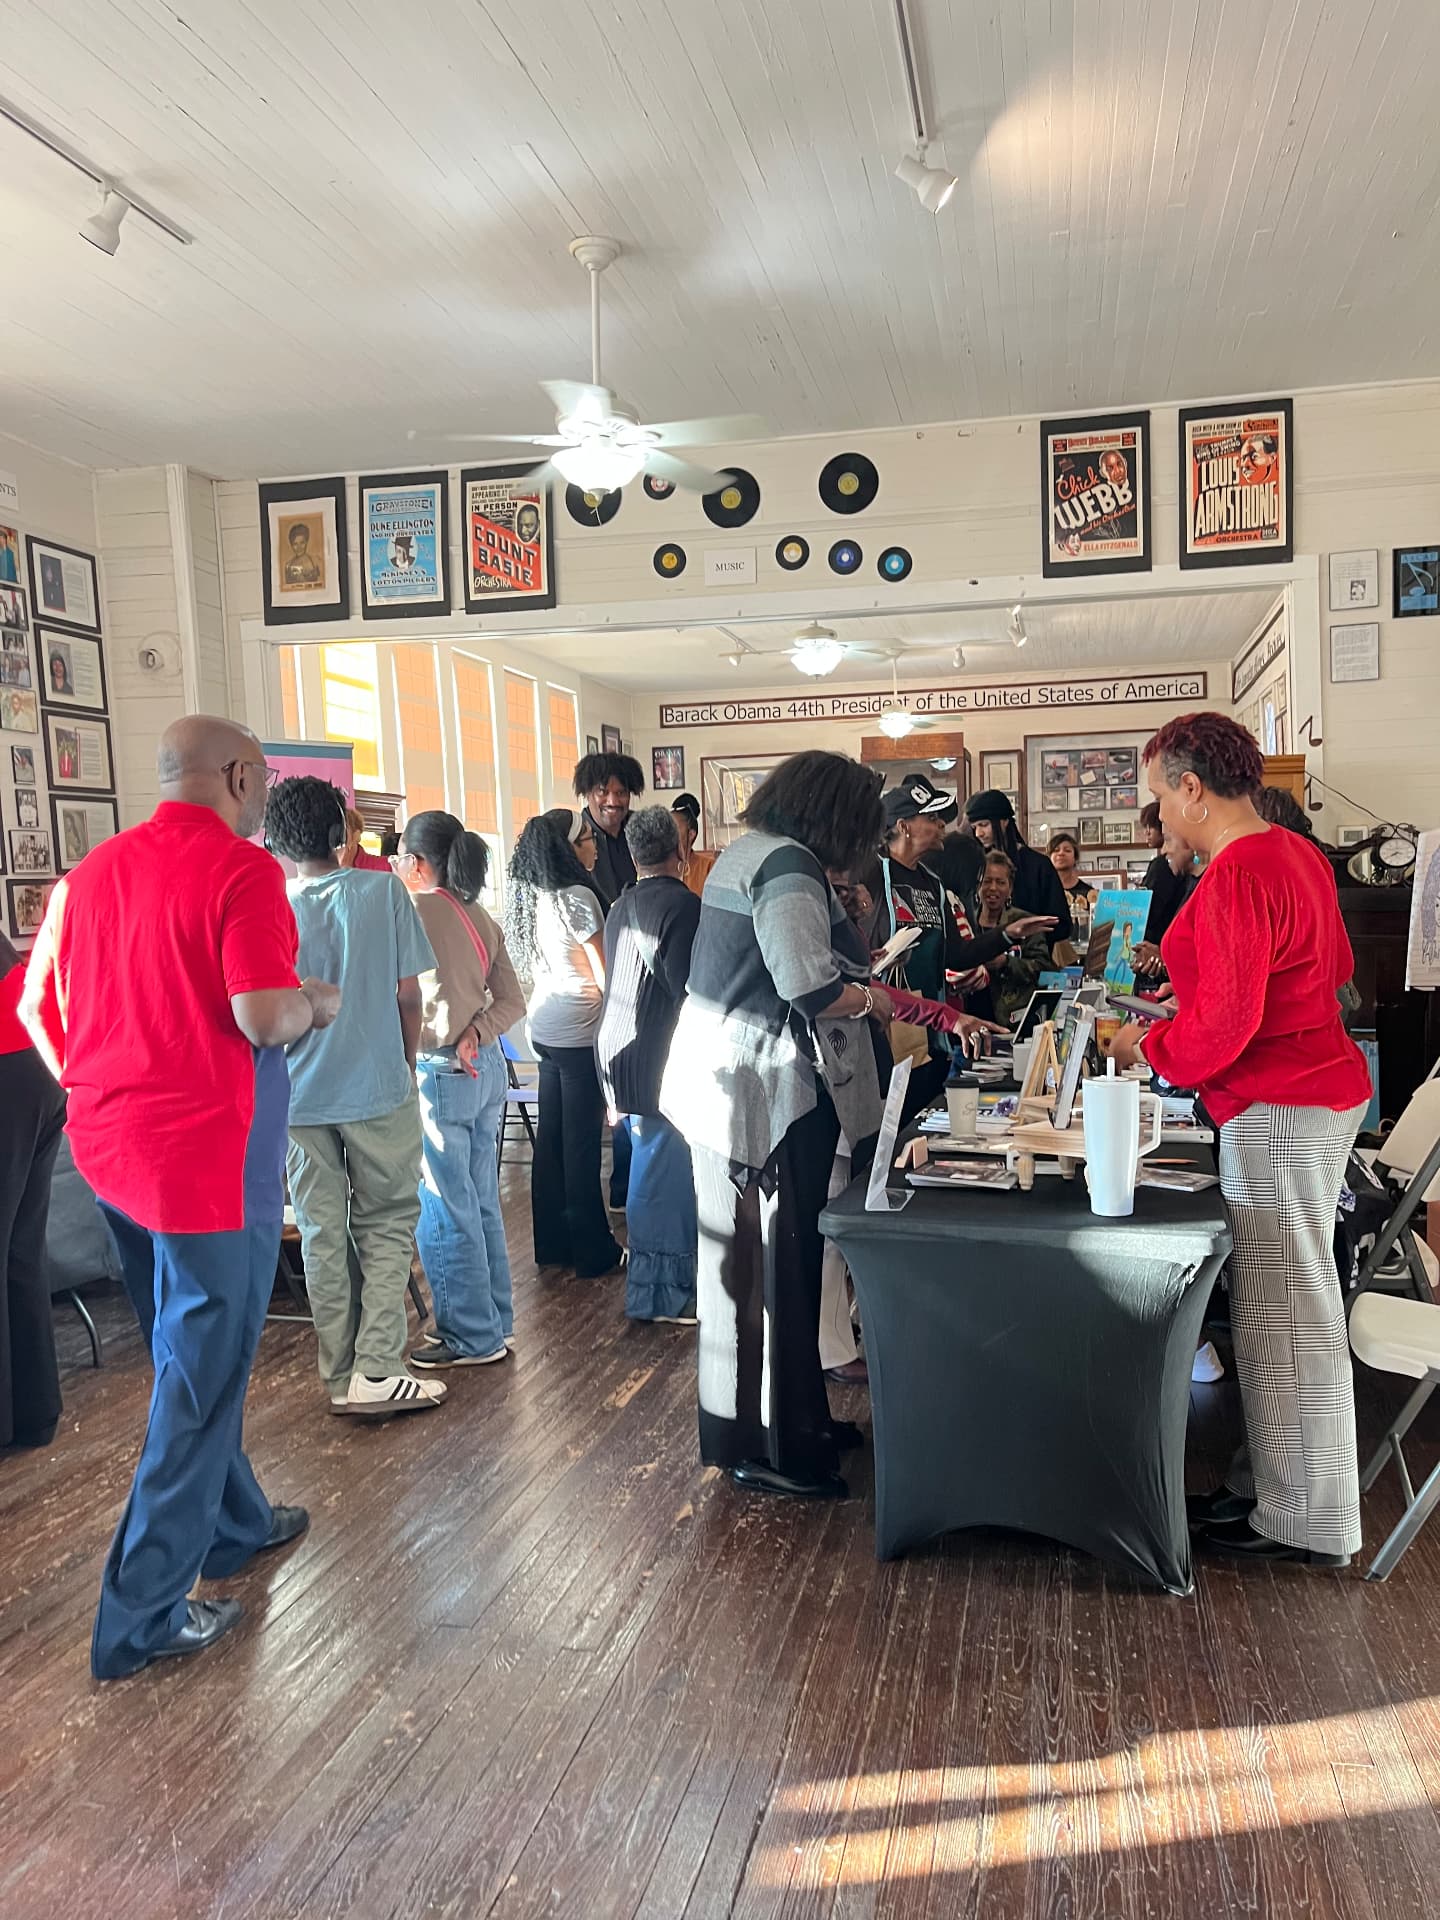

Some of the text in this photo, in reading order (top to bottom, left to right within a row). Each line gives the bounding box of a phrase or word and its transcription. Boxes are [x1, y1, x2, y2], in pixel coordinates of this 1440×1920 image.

[1057, 466, 1100, 500] Chick
[1201, 457, 1240, 492] LOUIS
[471, 504, 480, 512] IN
[484, 501, 518, 511] PERSON
[1054, 483, 1133, 529] WEBB
[1194, 481, 1279, 538] ARMSTRONG
[370, 518, 434, 532] DUKE ELLINGTON
[1216, 533, 1258, 543] ORCHESTRA
[474, 524, 537, 566] COUNT
[479, 545, 534, 587] BASIE
[715, 561, 745, 571] MUSIC
[664, 707, 718, 723] Barack
[724, 704, 781, 720] Obama
[787, 700, 825, 717] 44th
[916, 693, 934, 710] of
[939, 692, 967, 709] the
[974, 688, 1031, 707] United
[1038, 686, 1094, 704] States
[1100, 682, 1119, 700] of
[1125, 679, 1200, 698] America
